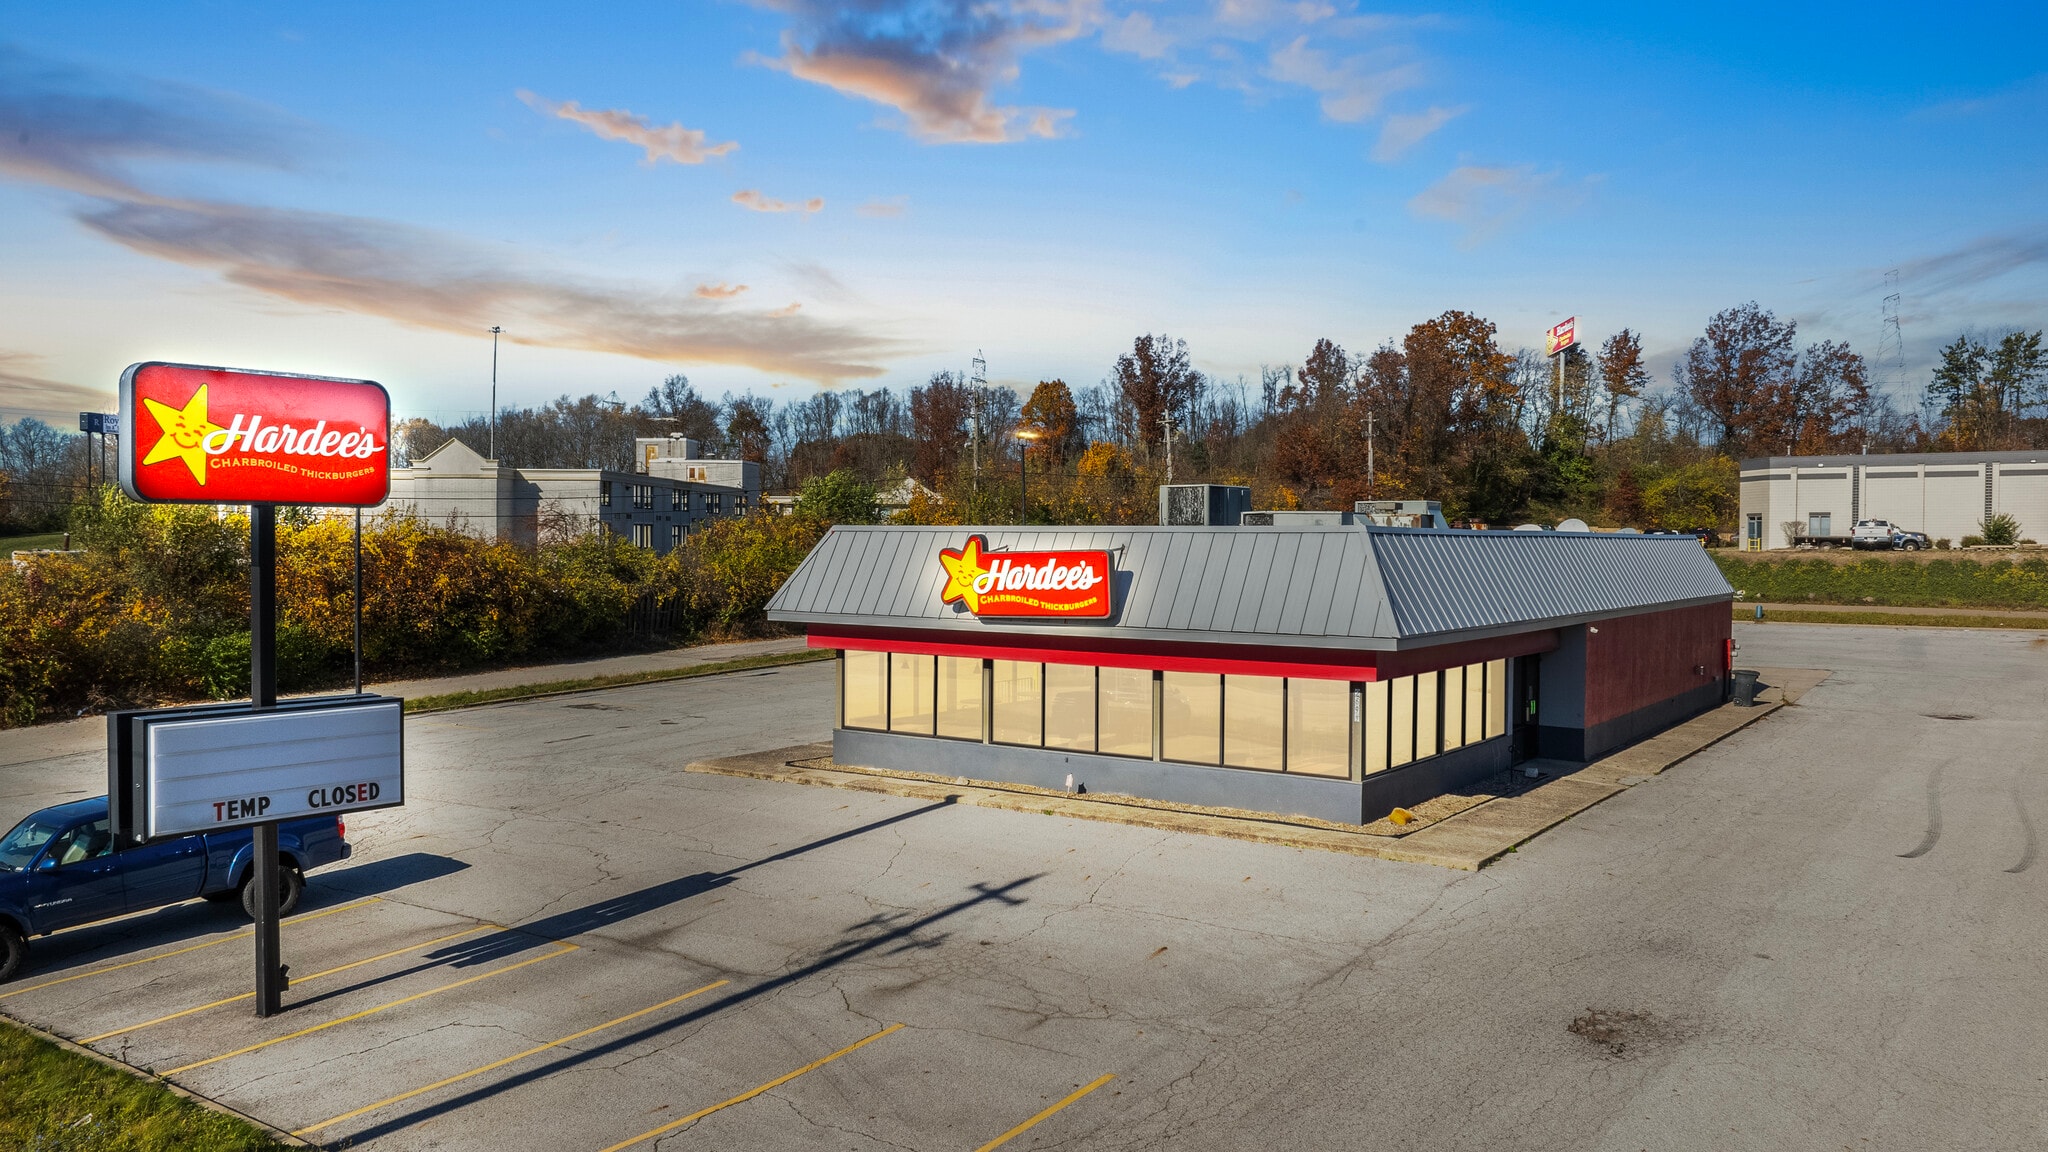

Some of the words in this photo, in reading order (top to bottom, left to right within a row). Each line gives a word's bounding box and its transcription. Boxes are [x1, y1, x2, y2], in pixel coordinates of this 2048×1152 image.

[202, 413, 385, 459] Hardee's
[210, 457, 298, 474] CHARBROILED
[300, 466, 375, 480] THICKBURGERS
[972, 558, 1103, 594] Hardee's
[980, 594, 1039, 607] CHARBROILED
[1040, 596, 1098, 611] THICKBURGERS
[213, 796, 271, 822] TEMP
[308, 782, 380, 808] CLOSED
